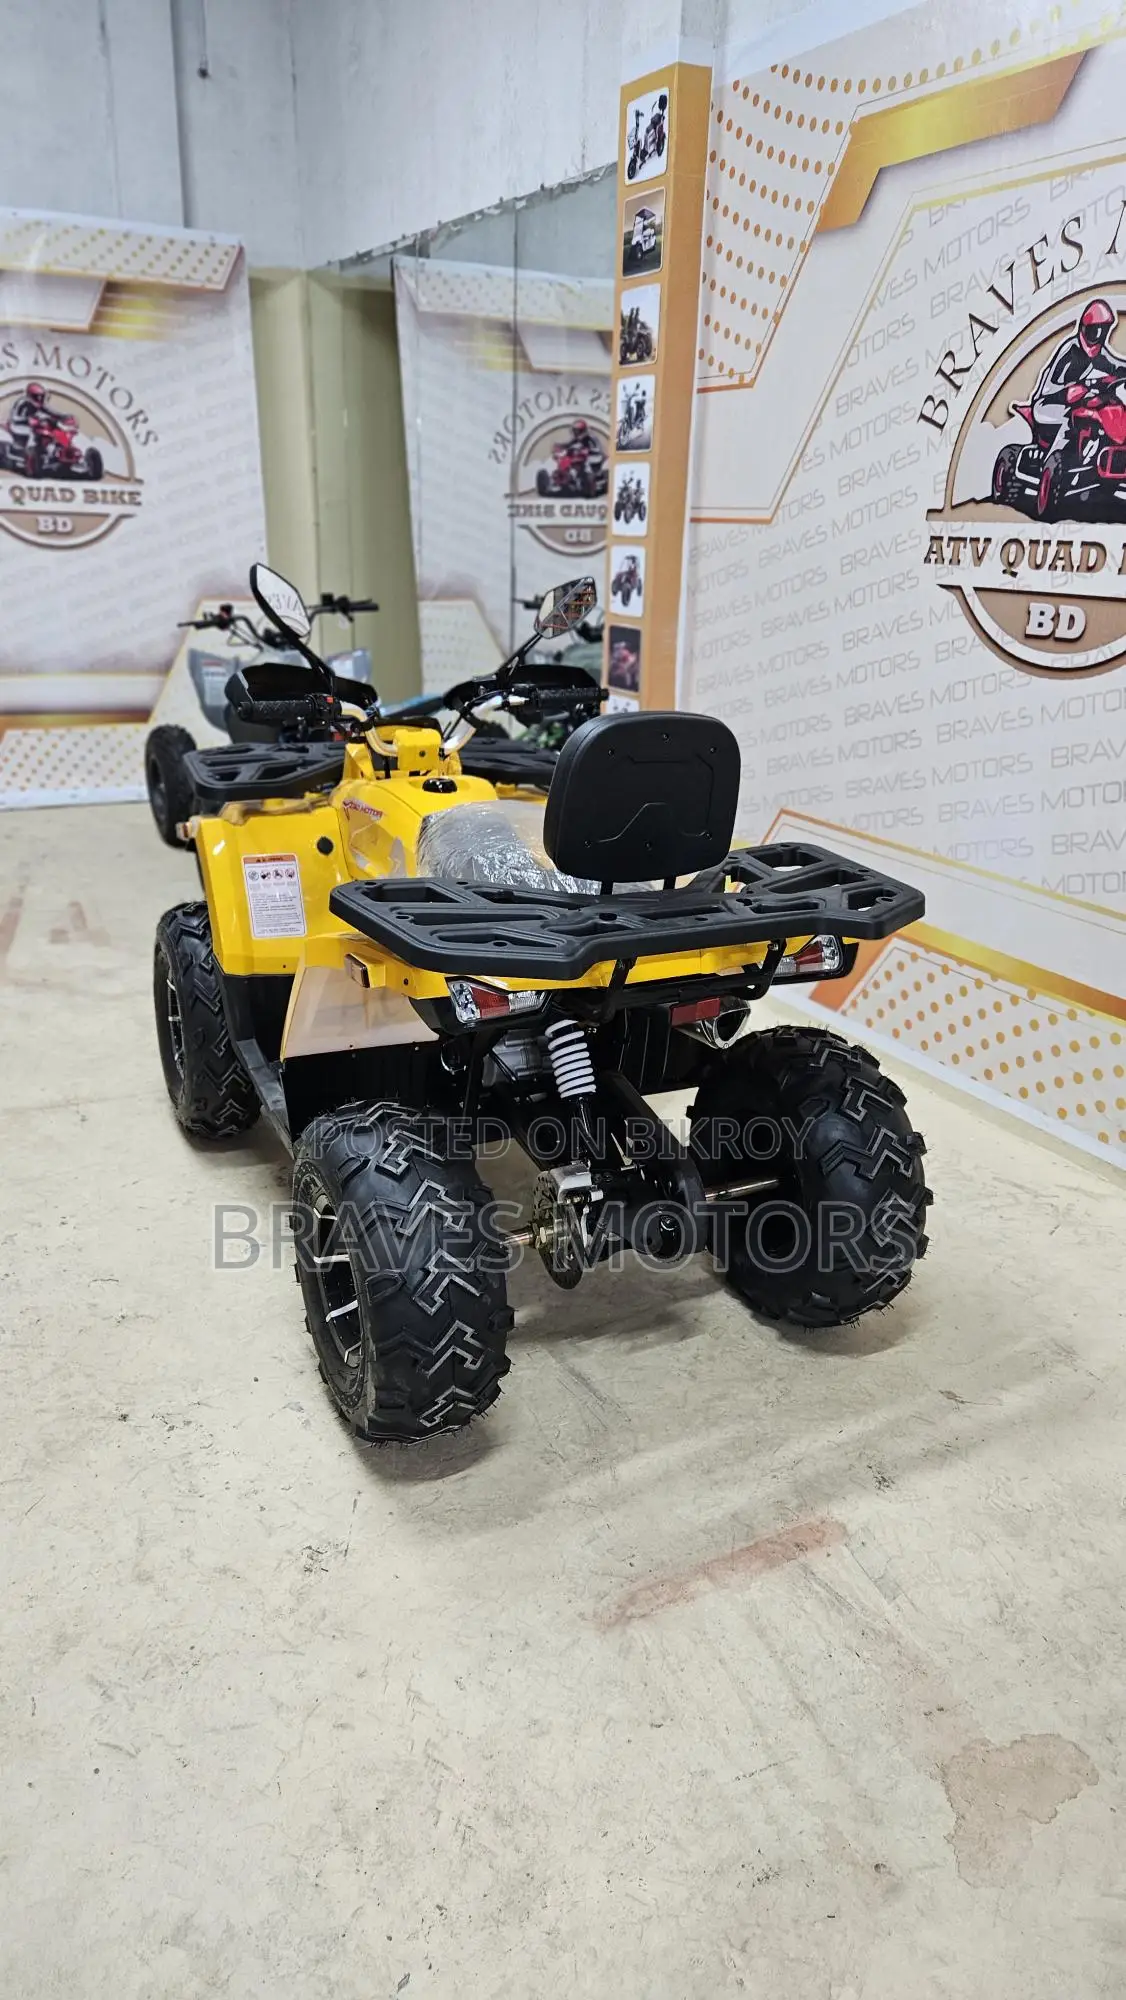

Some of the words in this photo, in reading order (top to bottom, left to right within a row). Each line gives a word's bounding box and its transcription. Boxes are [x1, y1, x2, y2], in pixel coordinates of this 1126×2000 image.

[924, 196, 1031, 282] MOTORS
[846, 312, 916, 368] OTORS
[930, 240, 1030, 319] BRAVES
[1039, 185, 1126, 256] MOTO
[917, 216, 1084, 436] BRAVES
[32, 342, 159, 447] MOTORS
[835, 357, 920, 418] BRAVES
[829, 400, 917, 460] MOTORS
[8, 484, 76, 506] QUAD
[82, 488, 143, 507] BIKE
[838, 443, 921, 497] BRAVES
[36, 515, 74, 535] BD
[758, 524, 827, 569] BRAVES
[831, 485, 918, 540] MOTORS
[924, 536, 992, 567] ATV
[1000, 537, 1107, 578] QUAD
[692, 594, 752, 631] BRAVES
[754, 565, 828, 607] MOTORS
[840, 528, 923, 576] BRAVES
[761, 600, 830, 640] BRAVES
[834, 568, 920, 616] MOTORS
[757, 640, 830, 675] MOTORS
[842, 609, 924, 652] BRAVES
[1024, 602, 1087, 642] BD
[760, 713, 833, 746] MOTORS
[844, 690, 924, 728] BRAVES
[930, 669, 1032, 709] MOTORS
[764, 674, 832, 708] BRAVES
[836, 650, 921, 690] MOTORS
[766, 747, 834, 777] BRAVES
[838, 729, 922, 764] MOTORS
[936, 706, 1034, 745] BRAVES
[1041, 687, 1126, 727] MOTO
[763, 784, 834, 811] MOTORS
[845, 769, 927, 799] BRAVES
[932, 752, 1033, 788] MOTORS
[1051, 738, 1126, 769] BRAV
[938, 792, 1034, 824] BRAVES
[1041, 781, 1126, 813] MOTO
[1051, 829, 1126, 856] BRAV
